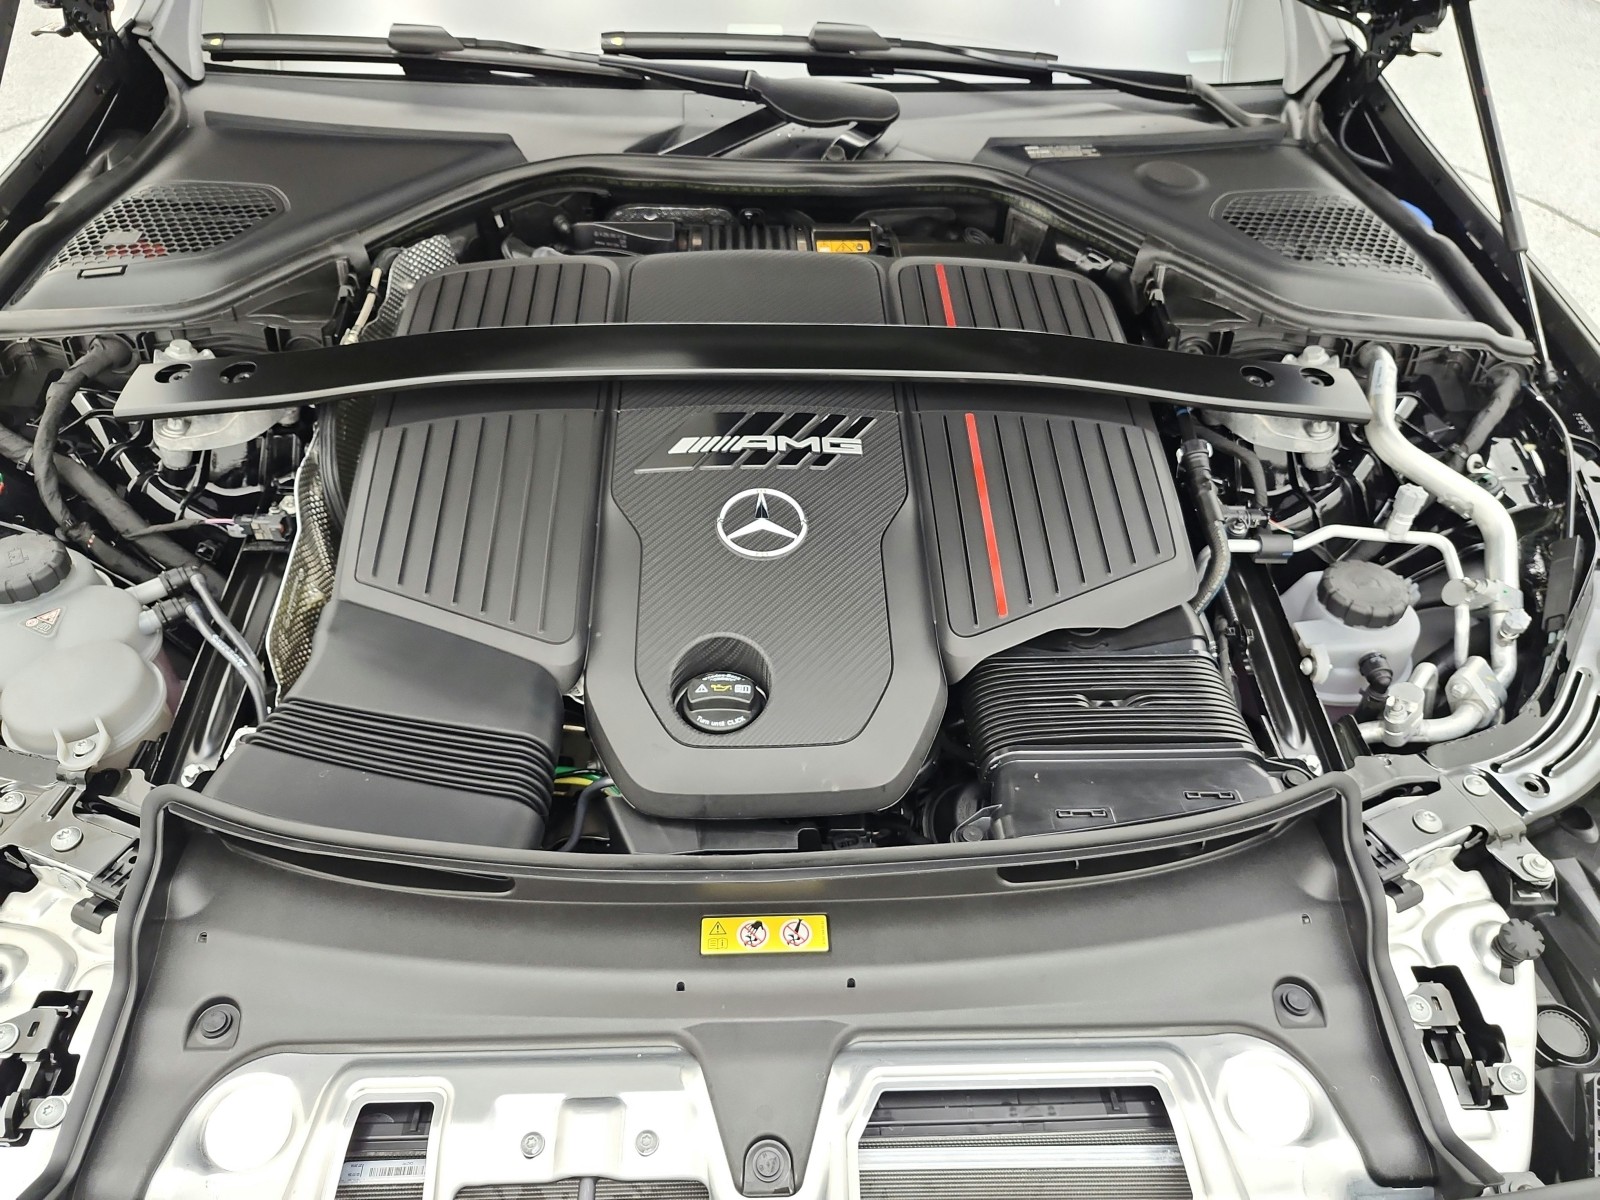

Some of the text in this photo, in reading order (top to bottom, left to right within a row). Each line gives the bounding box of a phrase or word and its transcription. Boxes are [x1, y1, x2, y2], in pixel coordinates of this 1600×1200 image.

[731, 435, 863, 455] AMG
[697, 715, 710, 725] Turn
[727, 715, 746, 726] CLICK
